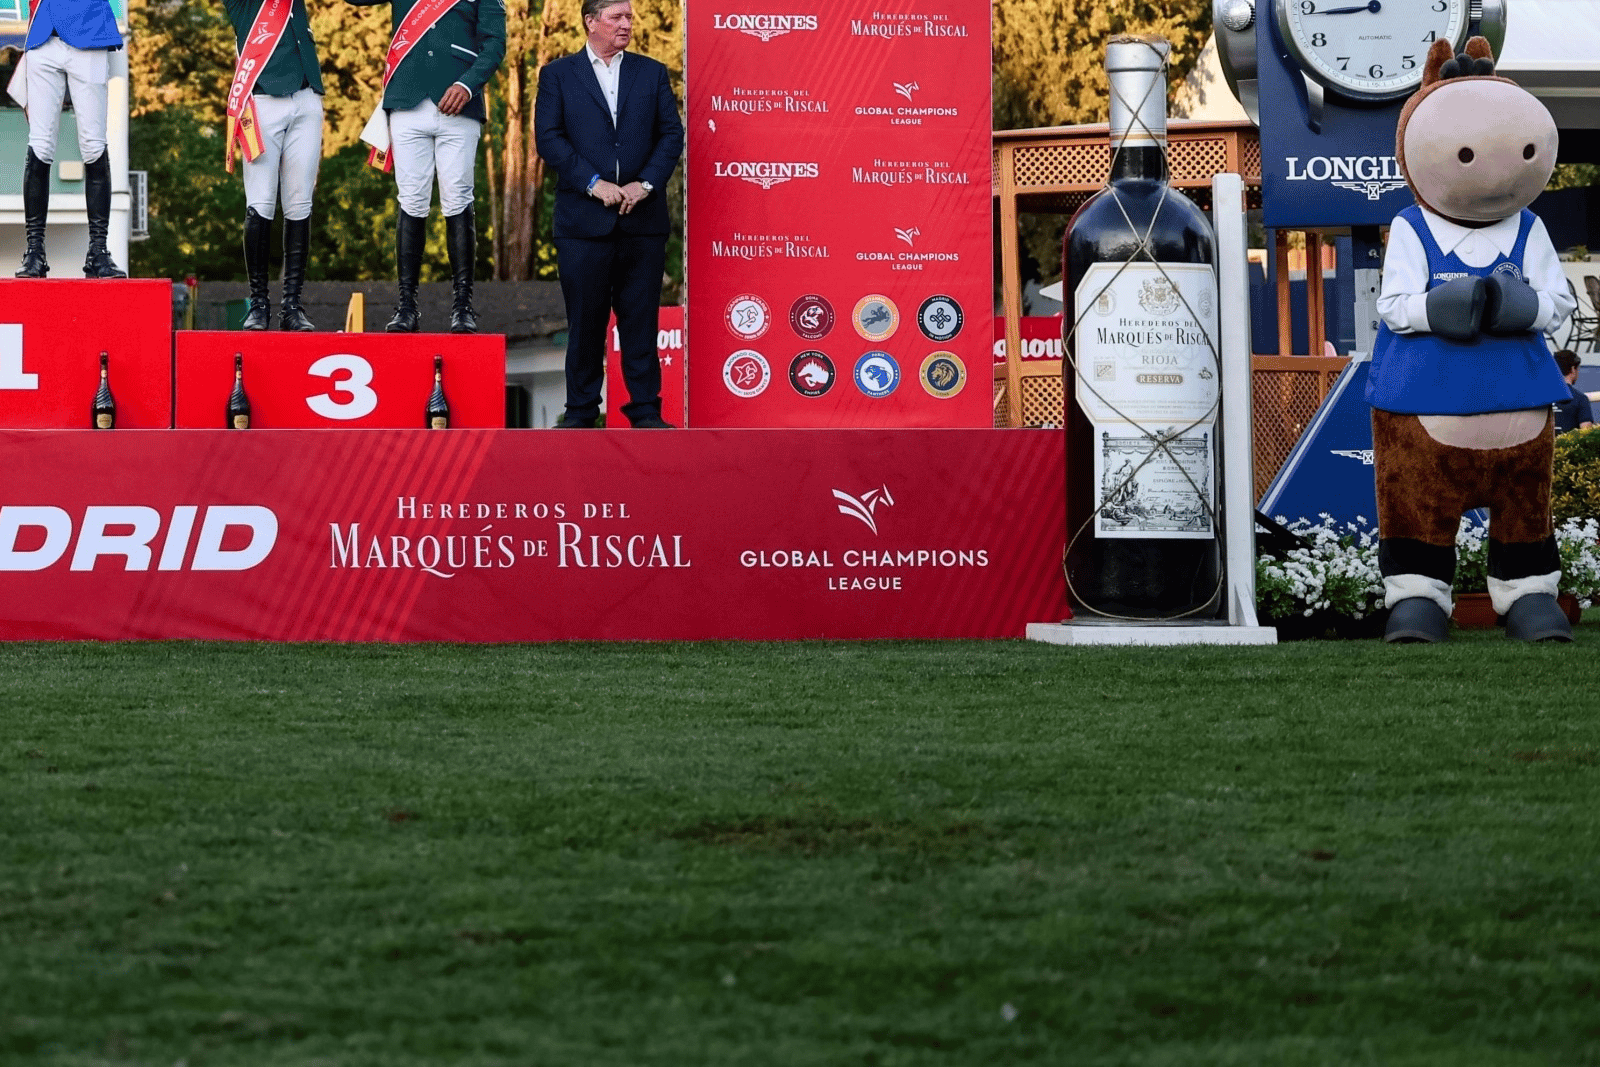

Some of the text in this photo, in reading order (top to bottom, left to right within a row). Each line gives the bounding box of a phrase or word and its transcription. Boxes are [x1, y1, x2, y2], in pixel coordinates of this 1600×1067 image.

[412, 4, 432, 26] GLOBAL
[1301, 0, 1315, 15] 9
[714, 15, 817, 30] LONGINES
[873, 12, 928, 20] HEREDEROS
[851, 20, 911, 39] MARQUÉS
[924, 21, 968, 36] RISCAL
[1422, 30, 1436, 42] 4
[1312, 32, 1326, 47] 8
[1336, 57, 1350, 70] 7
[1402, 55, 1416, 69] 5
[1369, 64, 1383, 78] 6
[229, 58, 256, 111] 2025
[733, 87, 790, 96] HEREDEROS
[711, 96, 772, 114] MARQUÉS
[785, 96, 828, 112] RISCAL
[855, 107, 957, 115] GLOBAL CHAMPIONS
[715, 162, 818, 177] LONGINES
[874, 159, 930, 167] HEREDEROS
[1286, 156, 1404, 180] LONGI
[852, 168, 912, 186] MARQUÉS
[925, 168, 969, 184] RISCAL
[734, 233, 790, 241] HEREDEROS
[712, 241, 772, 260] MARQUÉS
[786, 242, 829, 257] RISCAL
[898, 253, 959, 261] CHAMPIONS
[1120, 318, 1180, 327] HEREDEROS
[1097, 328, 1162, 348] MARQUÉS
[1142, 355, 1178, 364] RIOJA
[306, 354, 378, 419] 3
[1140, 375, 1180, 383] RESERVA
[398, 497, 630, 520] HEREDEROS DEL
[329, 523, 691, 578] MARQUÉS DE RISCAL
[740, 550, 989, 568] GLOBAL CHAMPIONS
[828, 577, 902, 591] LEAGUE
